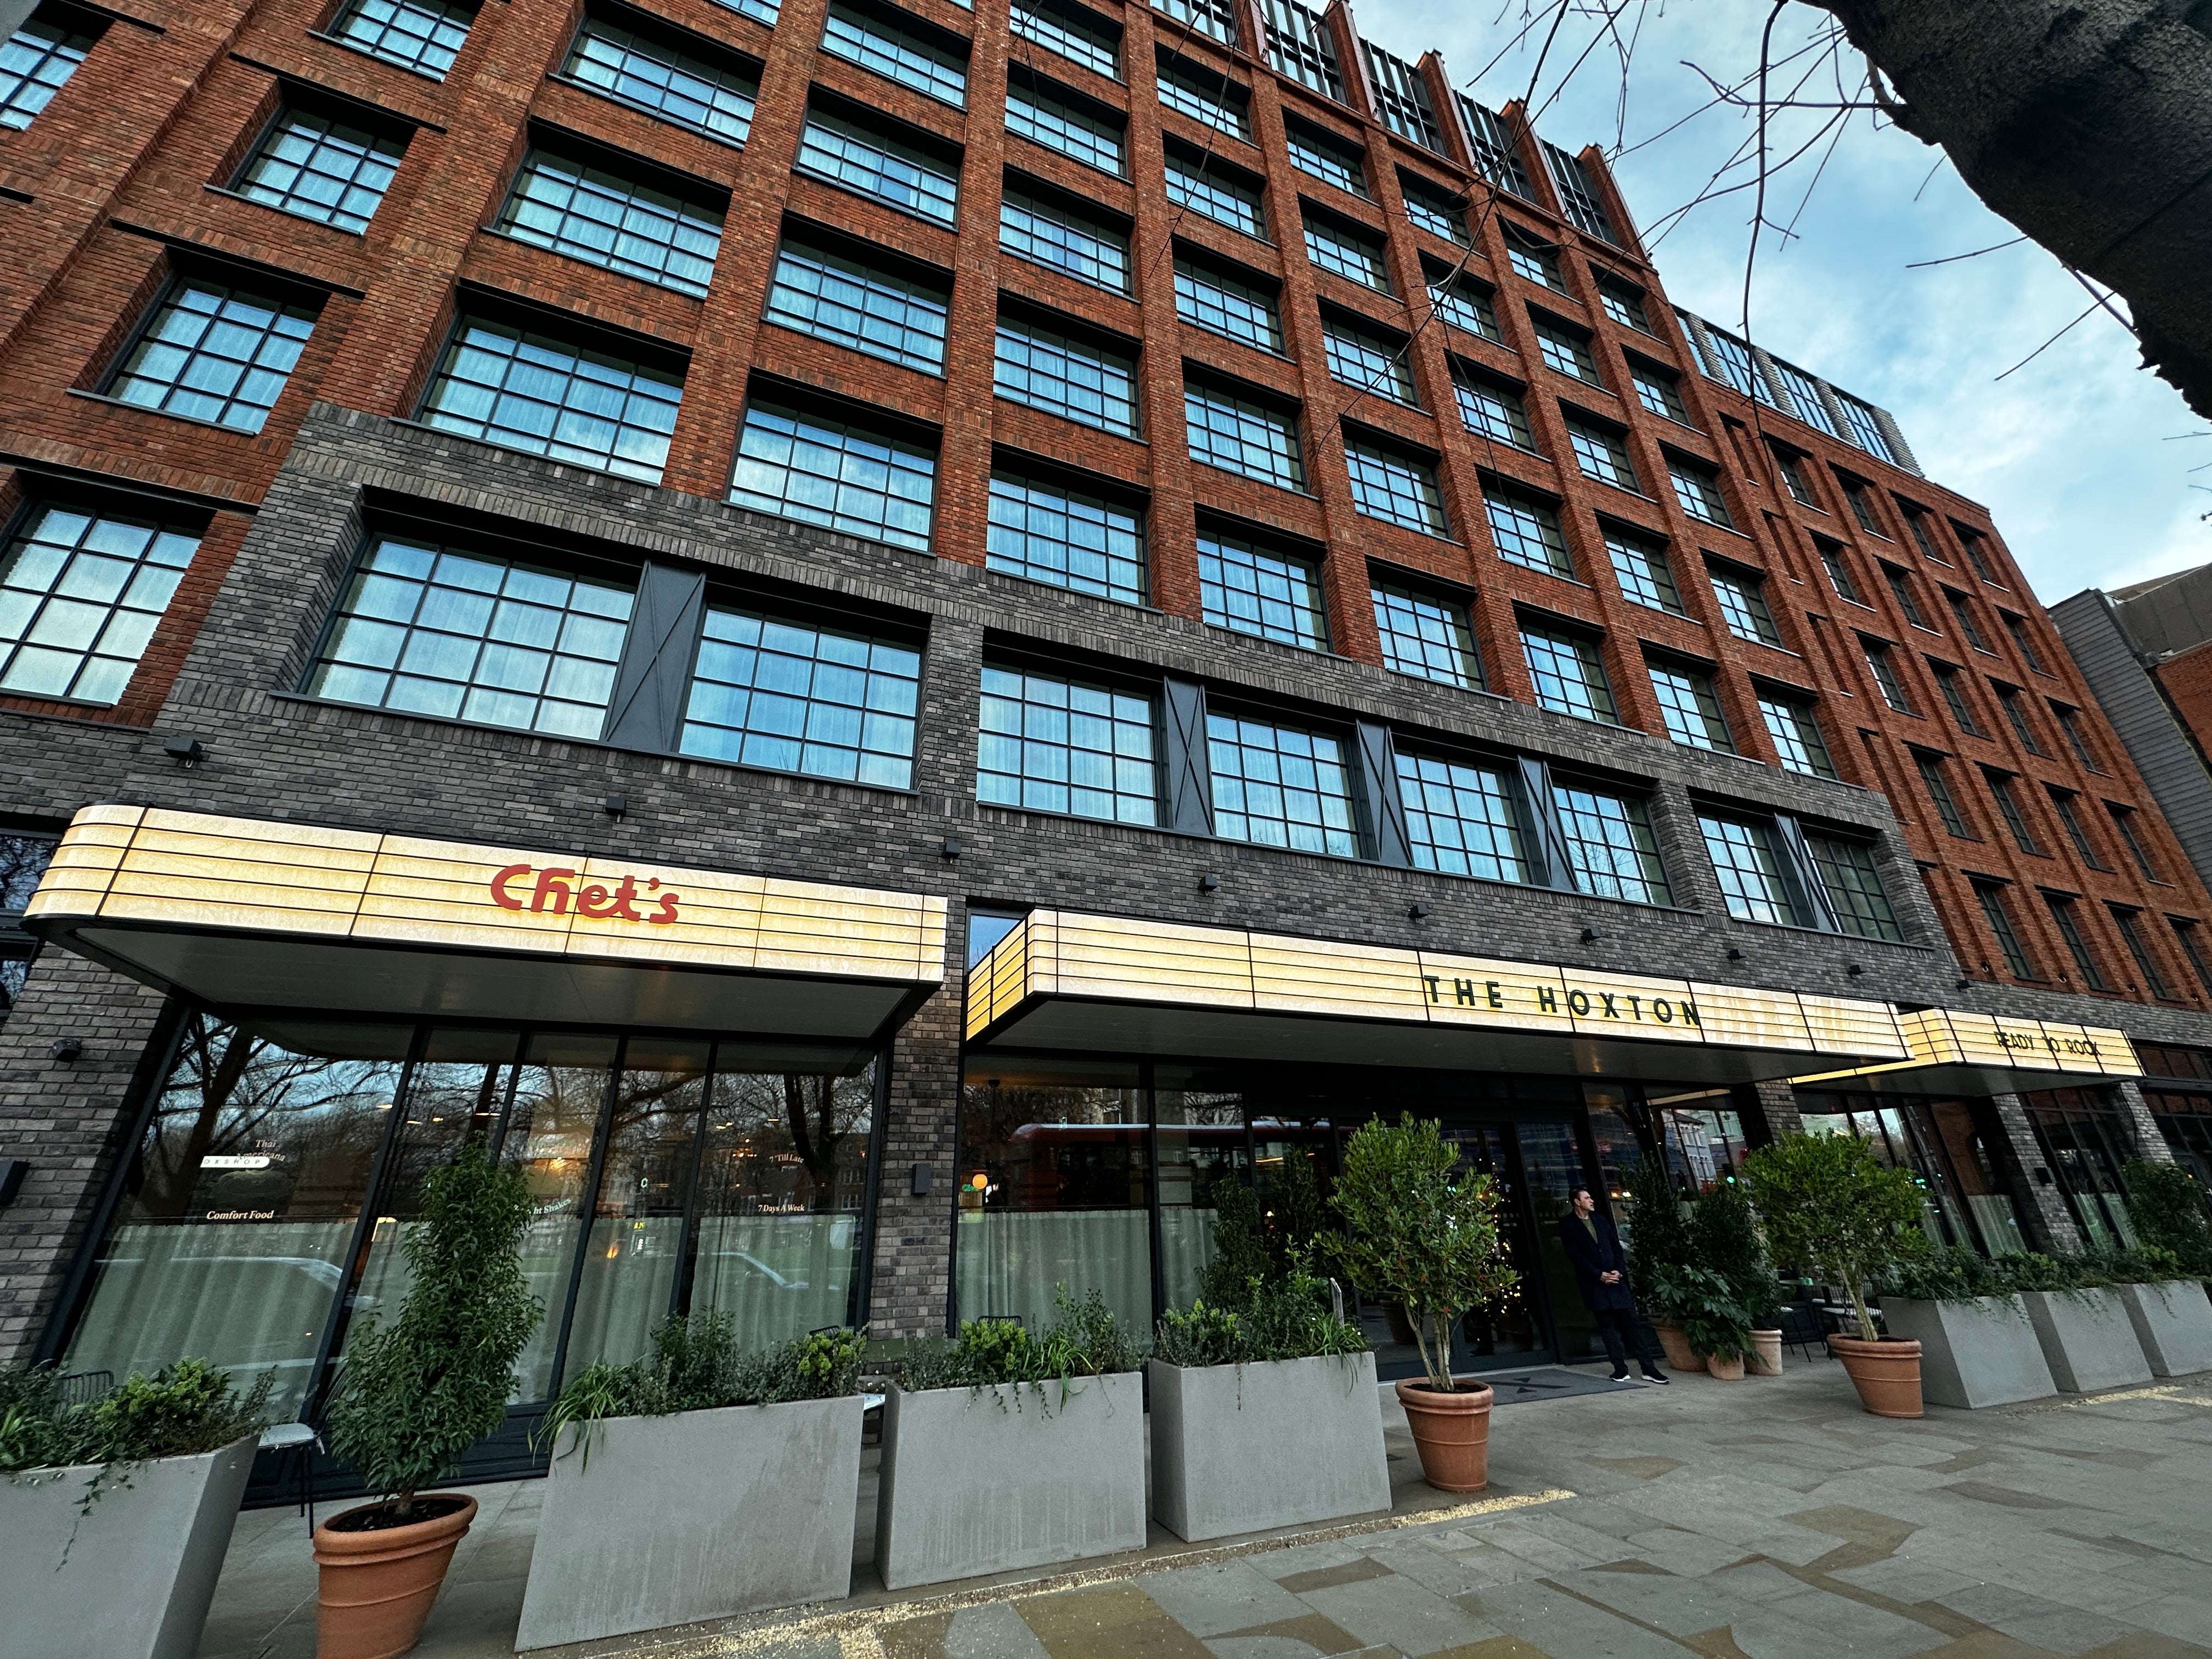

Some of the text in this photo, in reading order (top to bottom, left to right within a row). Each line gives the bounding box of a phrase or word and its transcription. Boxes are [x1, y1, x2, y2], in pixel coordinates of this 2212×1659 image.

[490, 864, 679, 924] Chet's
[1424, 975, 1700, 1026] THE HOXTON
[1994, 1031, 2034, 1050] READY
[2041, 1036, 2060, 1053] TO
[255, 1139, 277, 1148] Thai
[544, 1198, 571, 1214] Shakes
[763, 1204, 780, 1214] Days
[207, 1210, 274, 1219] Comfort Food
